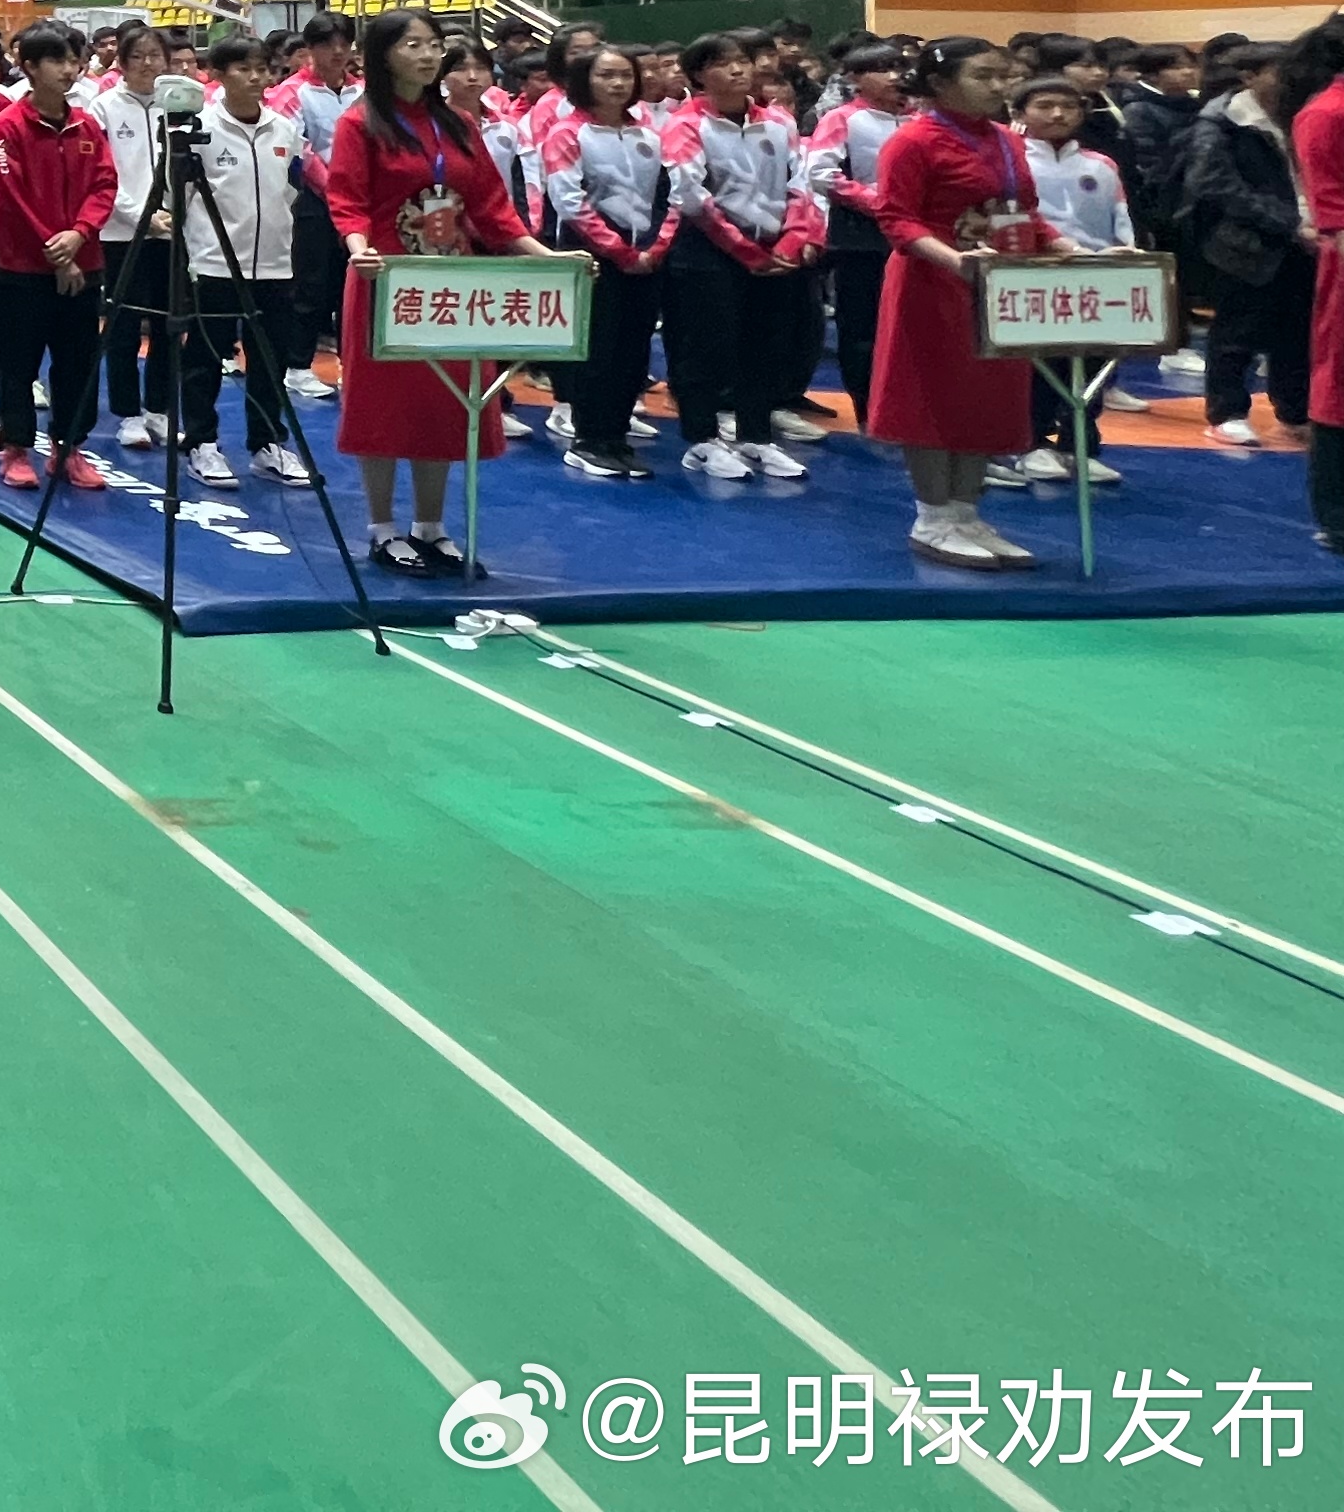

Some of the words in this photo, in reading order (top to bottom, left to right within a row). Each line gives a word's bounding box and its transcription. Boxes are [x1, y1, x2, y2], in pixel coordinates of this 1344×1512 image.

[392, 287, 569, 328] 德宏代表队
[997, 285, 1155, 325] 红河体校一队
